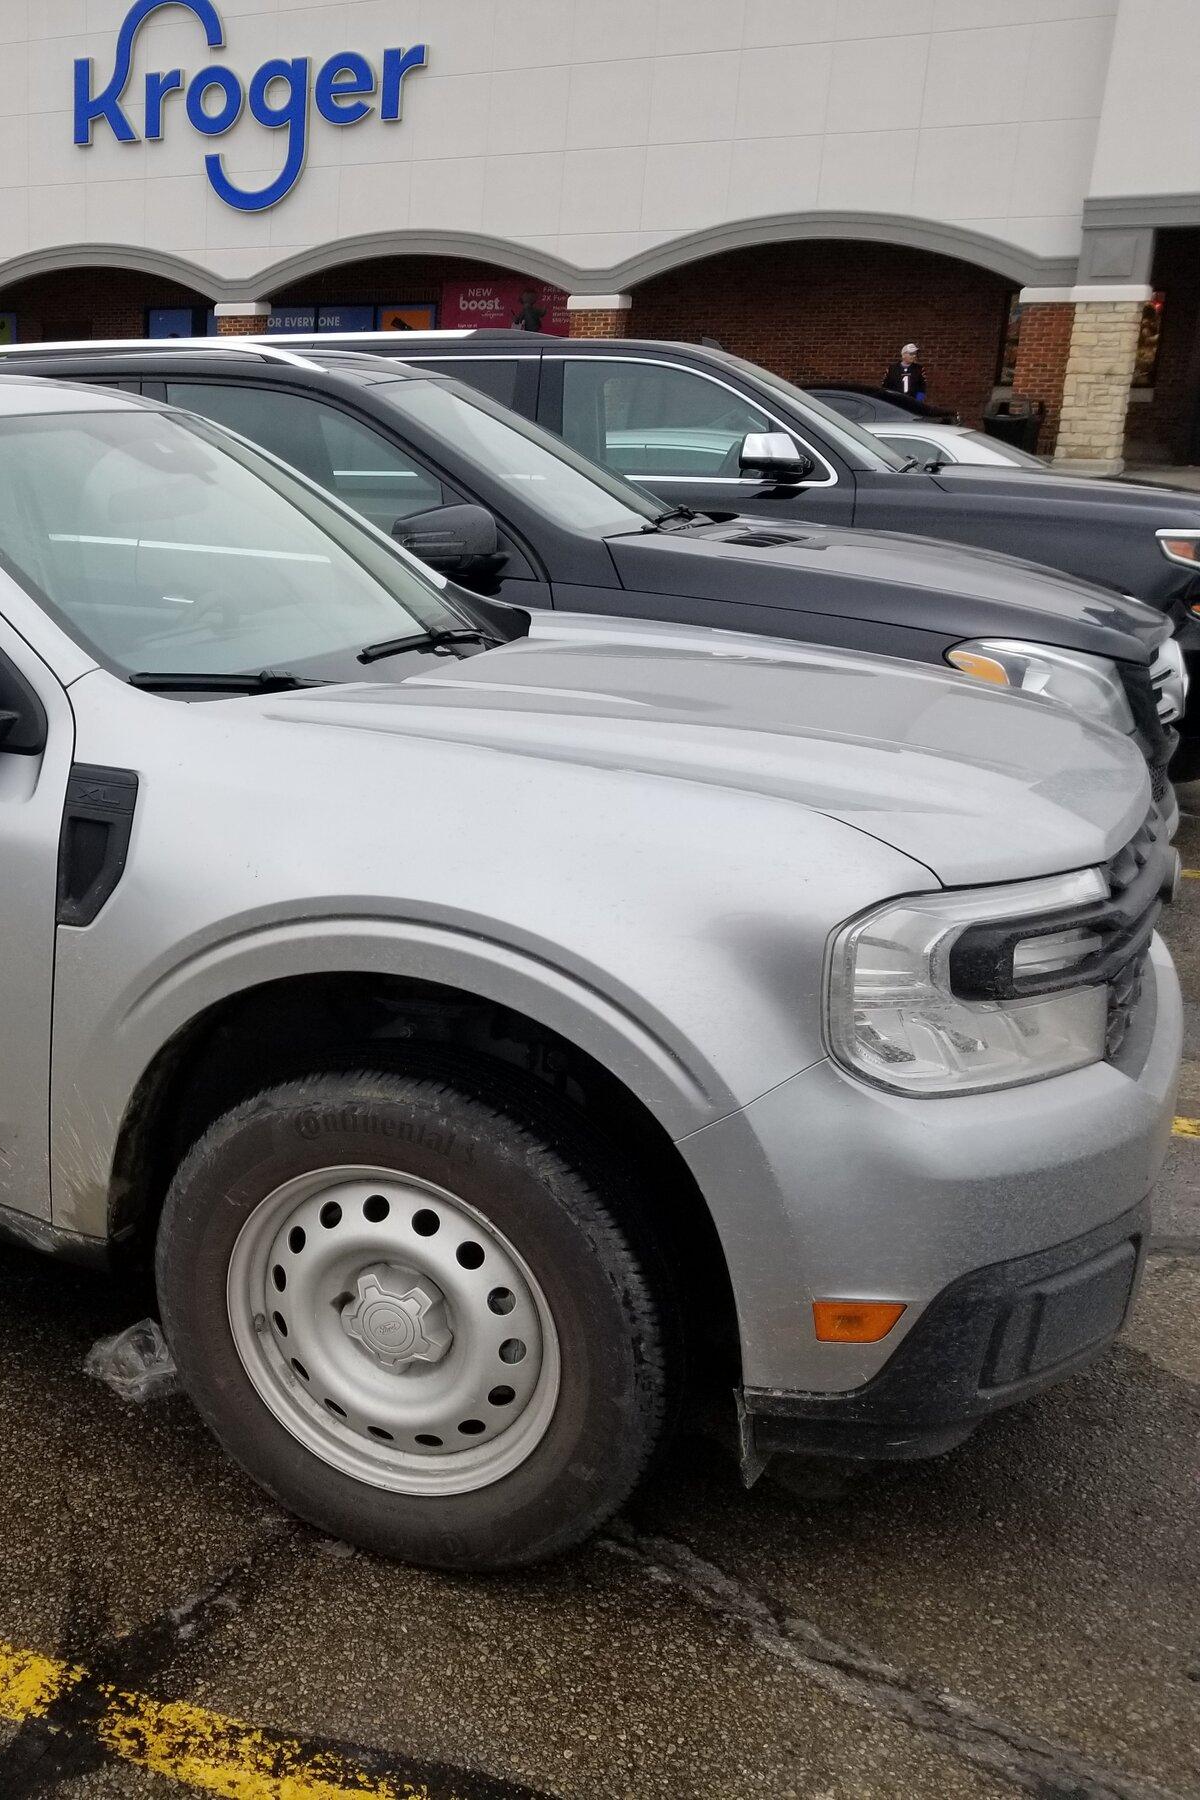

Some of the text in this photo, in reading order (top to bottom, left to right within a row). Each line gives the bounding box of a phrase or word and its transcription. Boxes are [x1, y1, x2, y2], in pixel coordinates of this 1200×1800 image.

[74, 0, 429, 212] Kroger
[468, 288, 492, 297] NEW
[459, 294, 501, 311] boost
[902, 375, 909, 393] 1
[77, 786, 121, 806] XL
[294, 1105, 457, 1156] Continental
